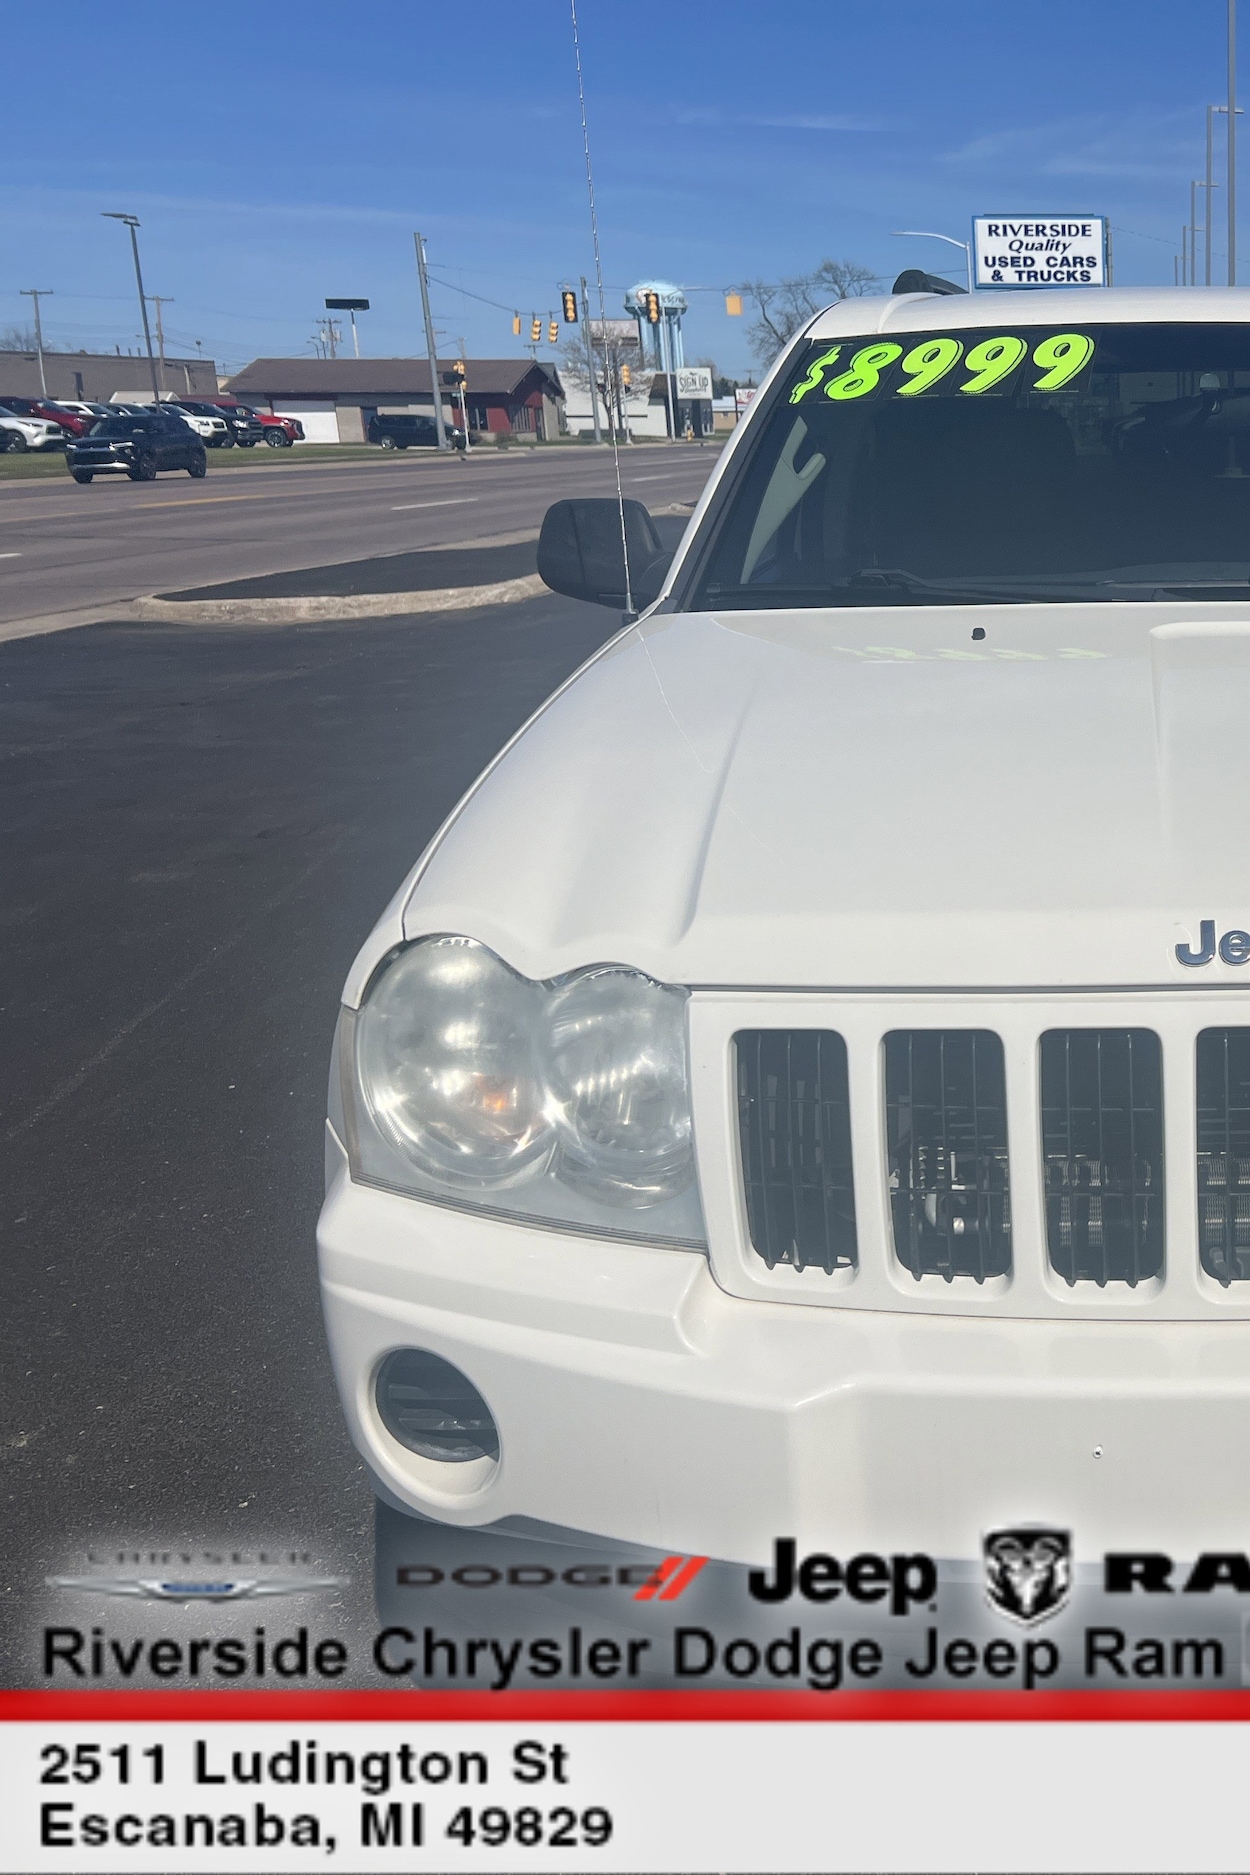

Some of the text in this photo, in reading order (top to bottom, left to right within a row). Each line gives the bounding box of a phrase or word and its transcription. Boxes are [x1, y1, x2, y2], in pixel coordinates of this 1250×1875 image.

[987, 224, 1092, 237] RIVERSIDE
[1008, 239, 1072, 255] Quality
[984, 256, 1097, 268] USED CARS
[991, 269, 1092, 282] & TRUCKS
[789, 333, 1096, 405] $8999
